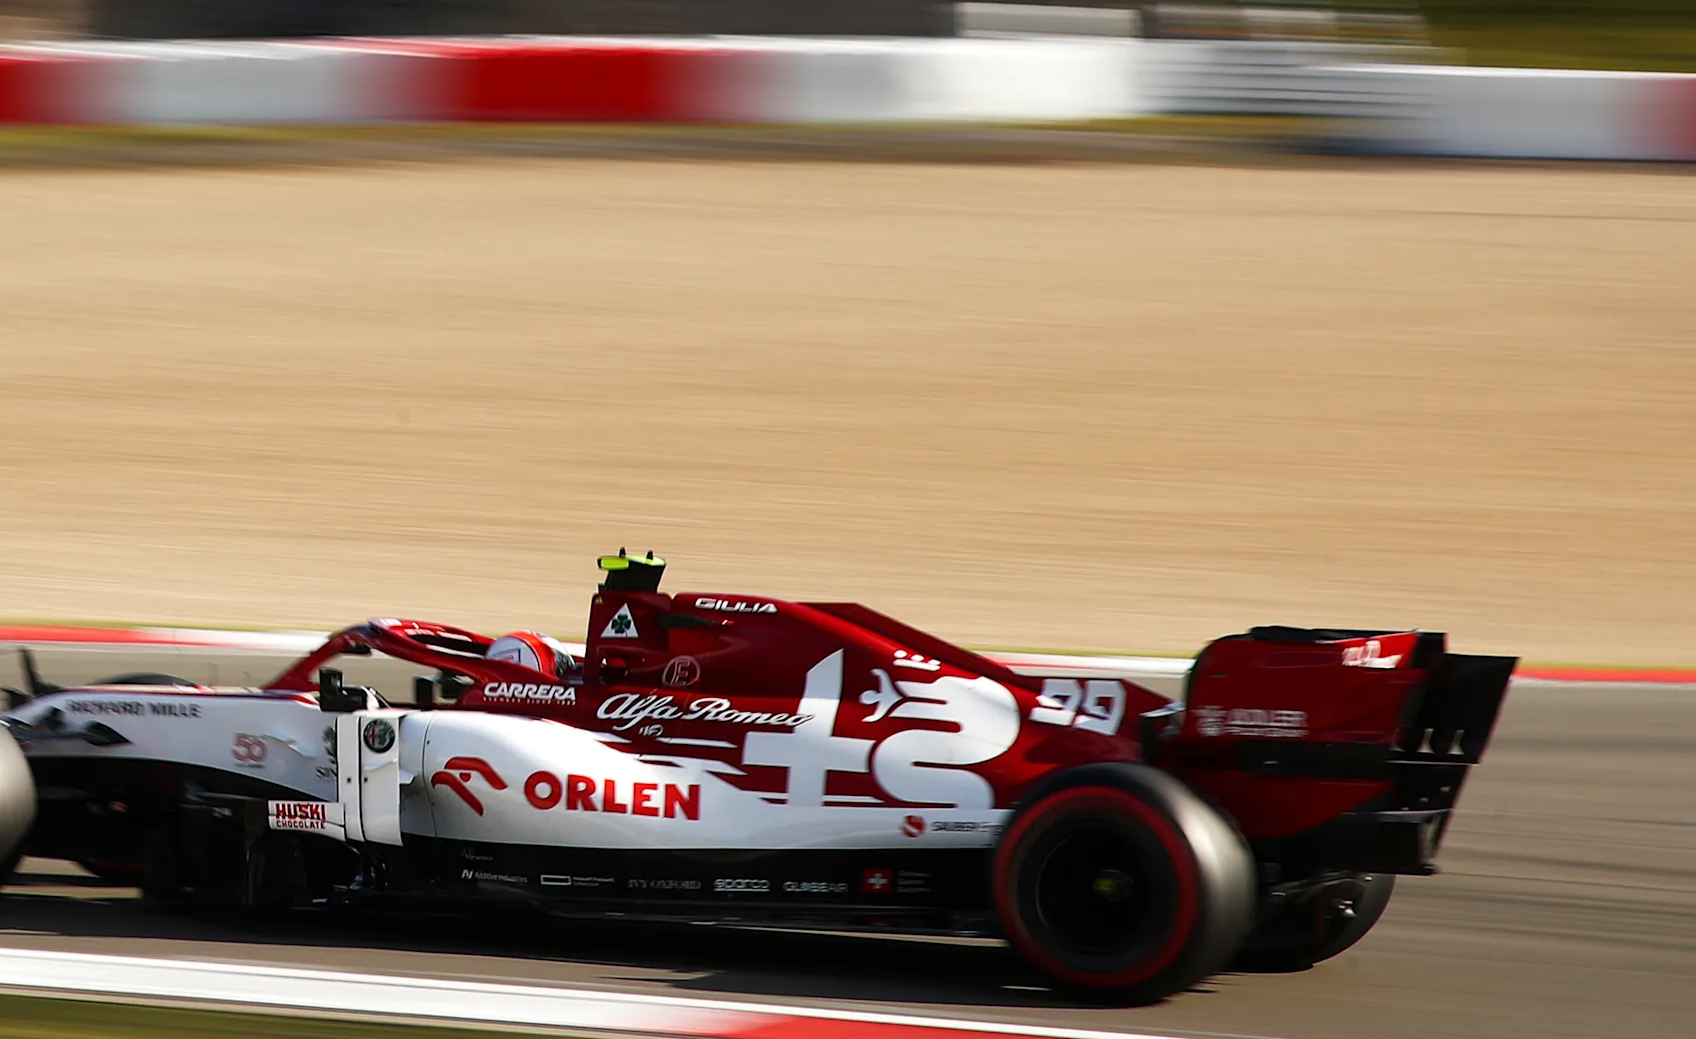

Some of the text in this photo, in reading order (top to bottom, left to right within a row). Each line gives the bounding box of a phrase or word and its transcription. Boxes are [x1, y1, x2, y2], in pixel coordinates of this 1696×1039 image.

[695, 597, 778, 614] GIULIA
[484, 682, 576, 701] CARRERA
[67, 700, 202, 719] RICHARD MILLE
[596, 693, 815, 731] Alfa Romeo
[1029, 678, 1127, 736] 99
[523, 769, 702, 822] ORLEN
[275, 803, 327, 821] HUSKI
[276, 820, 326, 830] CHOCOLATE
